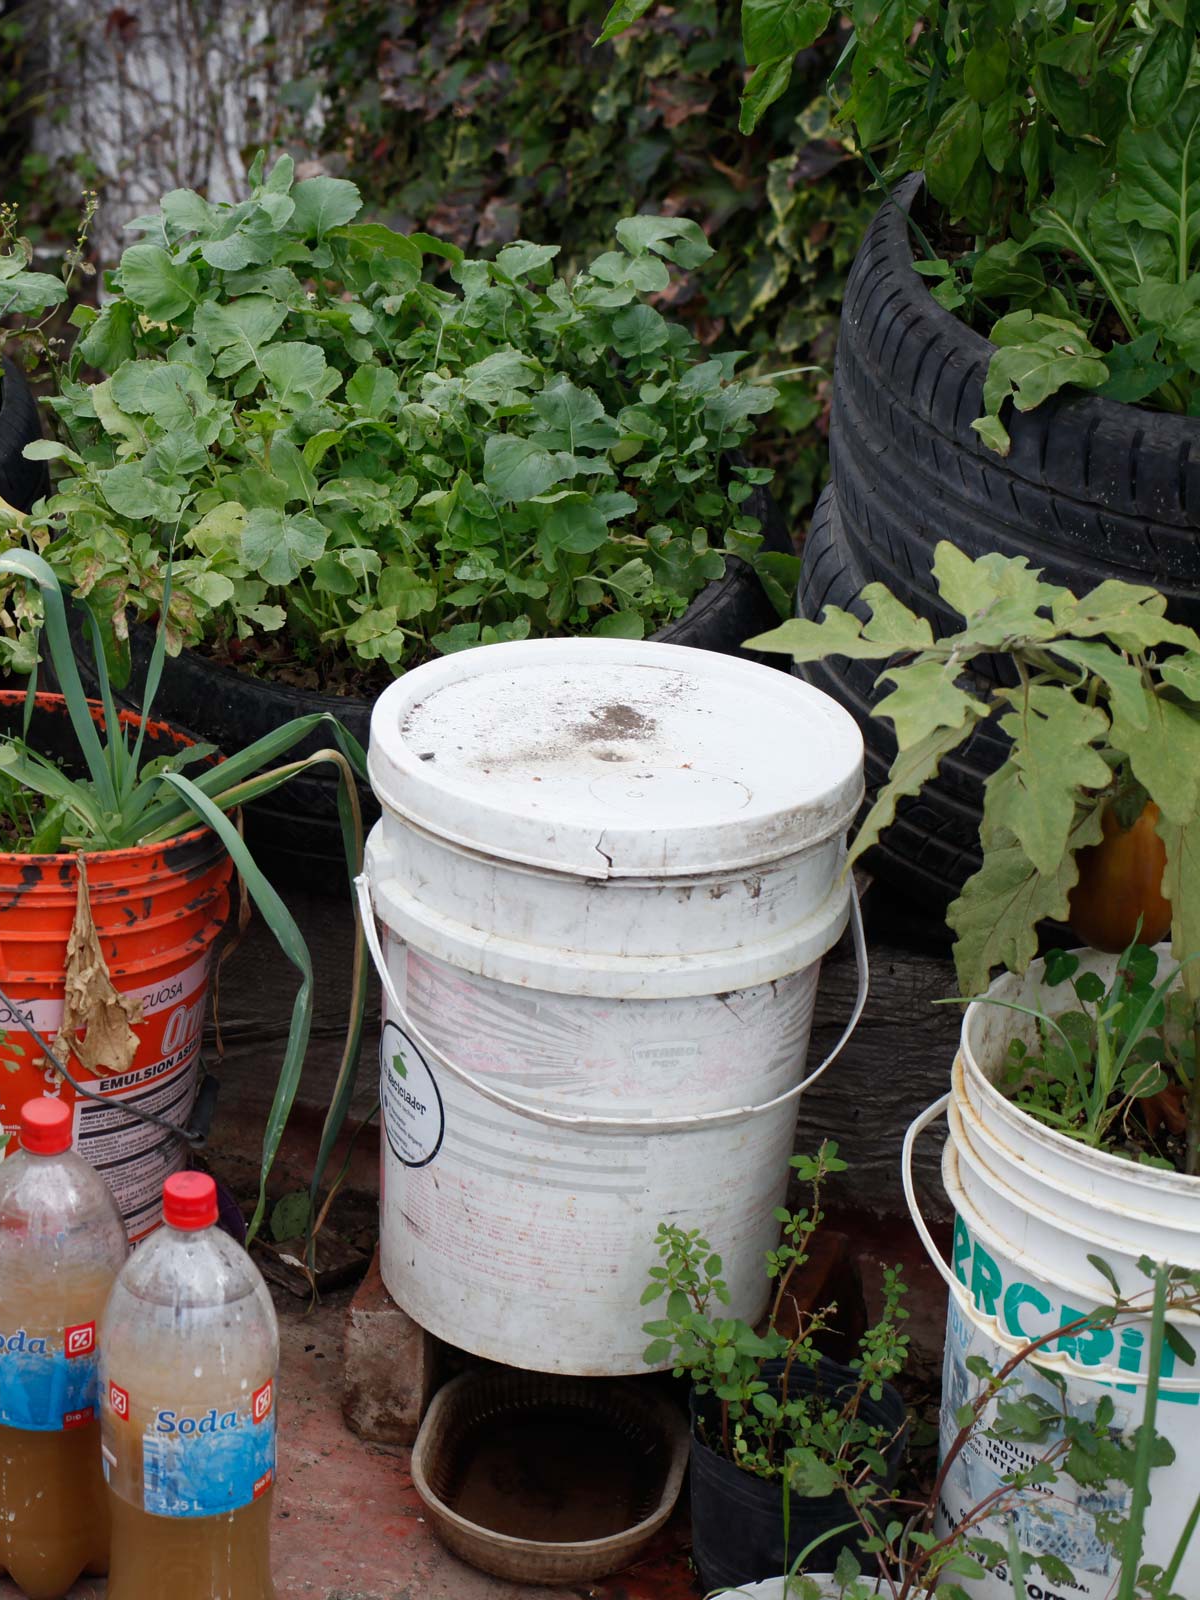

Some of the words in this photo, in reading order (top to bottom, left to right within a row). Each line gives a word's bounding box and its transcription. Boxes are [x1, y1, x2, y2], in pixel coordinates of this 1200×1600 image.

[143, 981, 183, 1009] CUOSA
[99, 1056, 174, 1091] EMULSION
[157, 1409, 237, 1434] Soda
